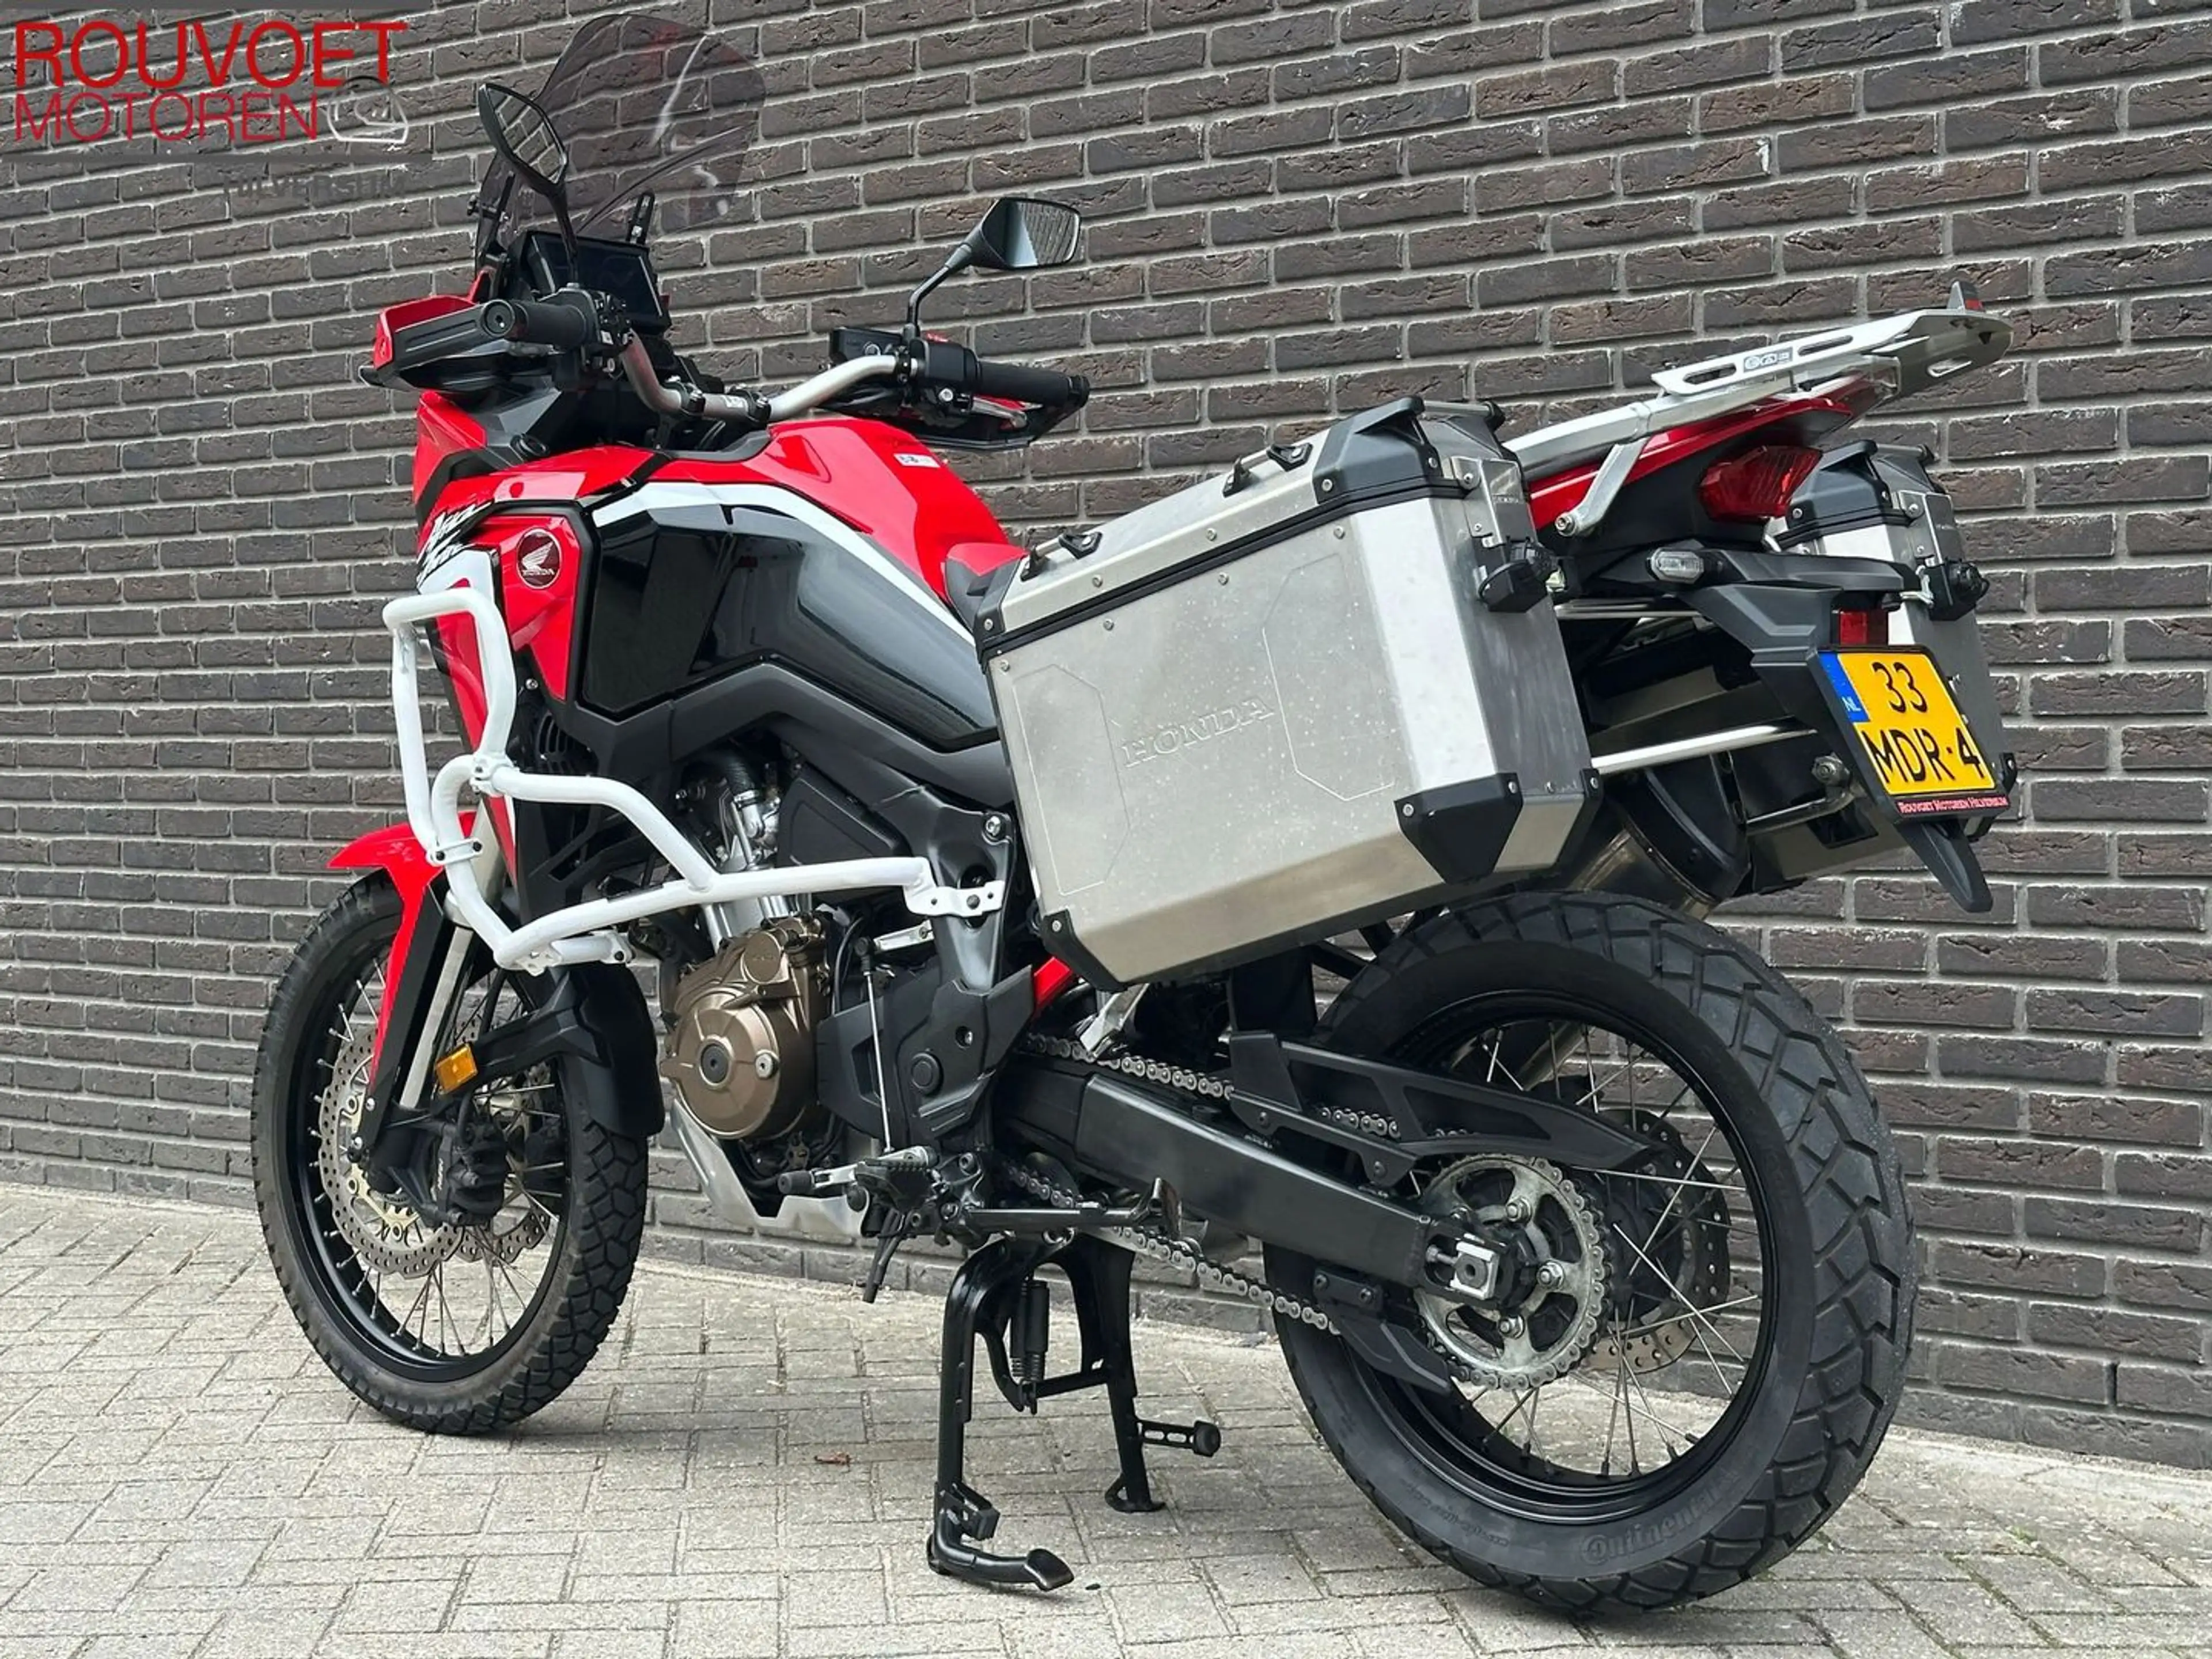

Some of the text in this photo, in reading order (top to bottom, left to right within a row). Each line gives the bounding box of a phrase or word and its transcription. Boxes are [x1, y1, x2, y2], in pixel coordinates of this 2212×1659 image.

[1841, 696, 1862, 712] NL
[1871, 661, 1928, 713] 33
[1121, 696, 1275, 768] HONDA
[1861, 728, 1984, 783] MDR-4
